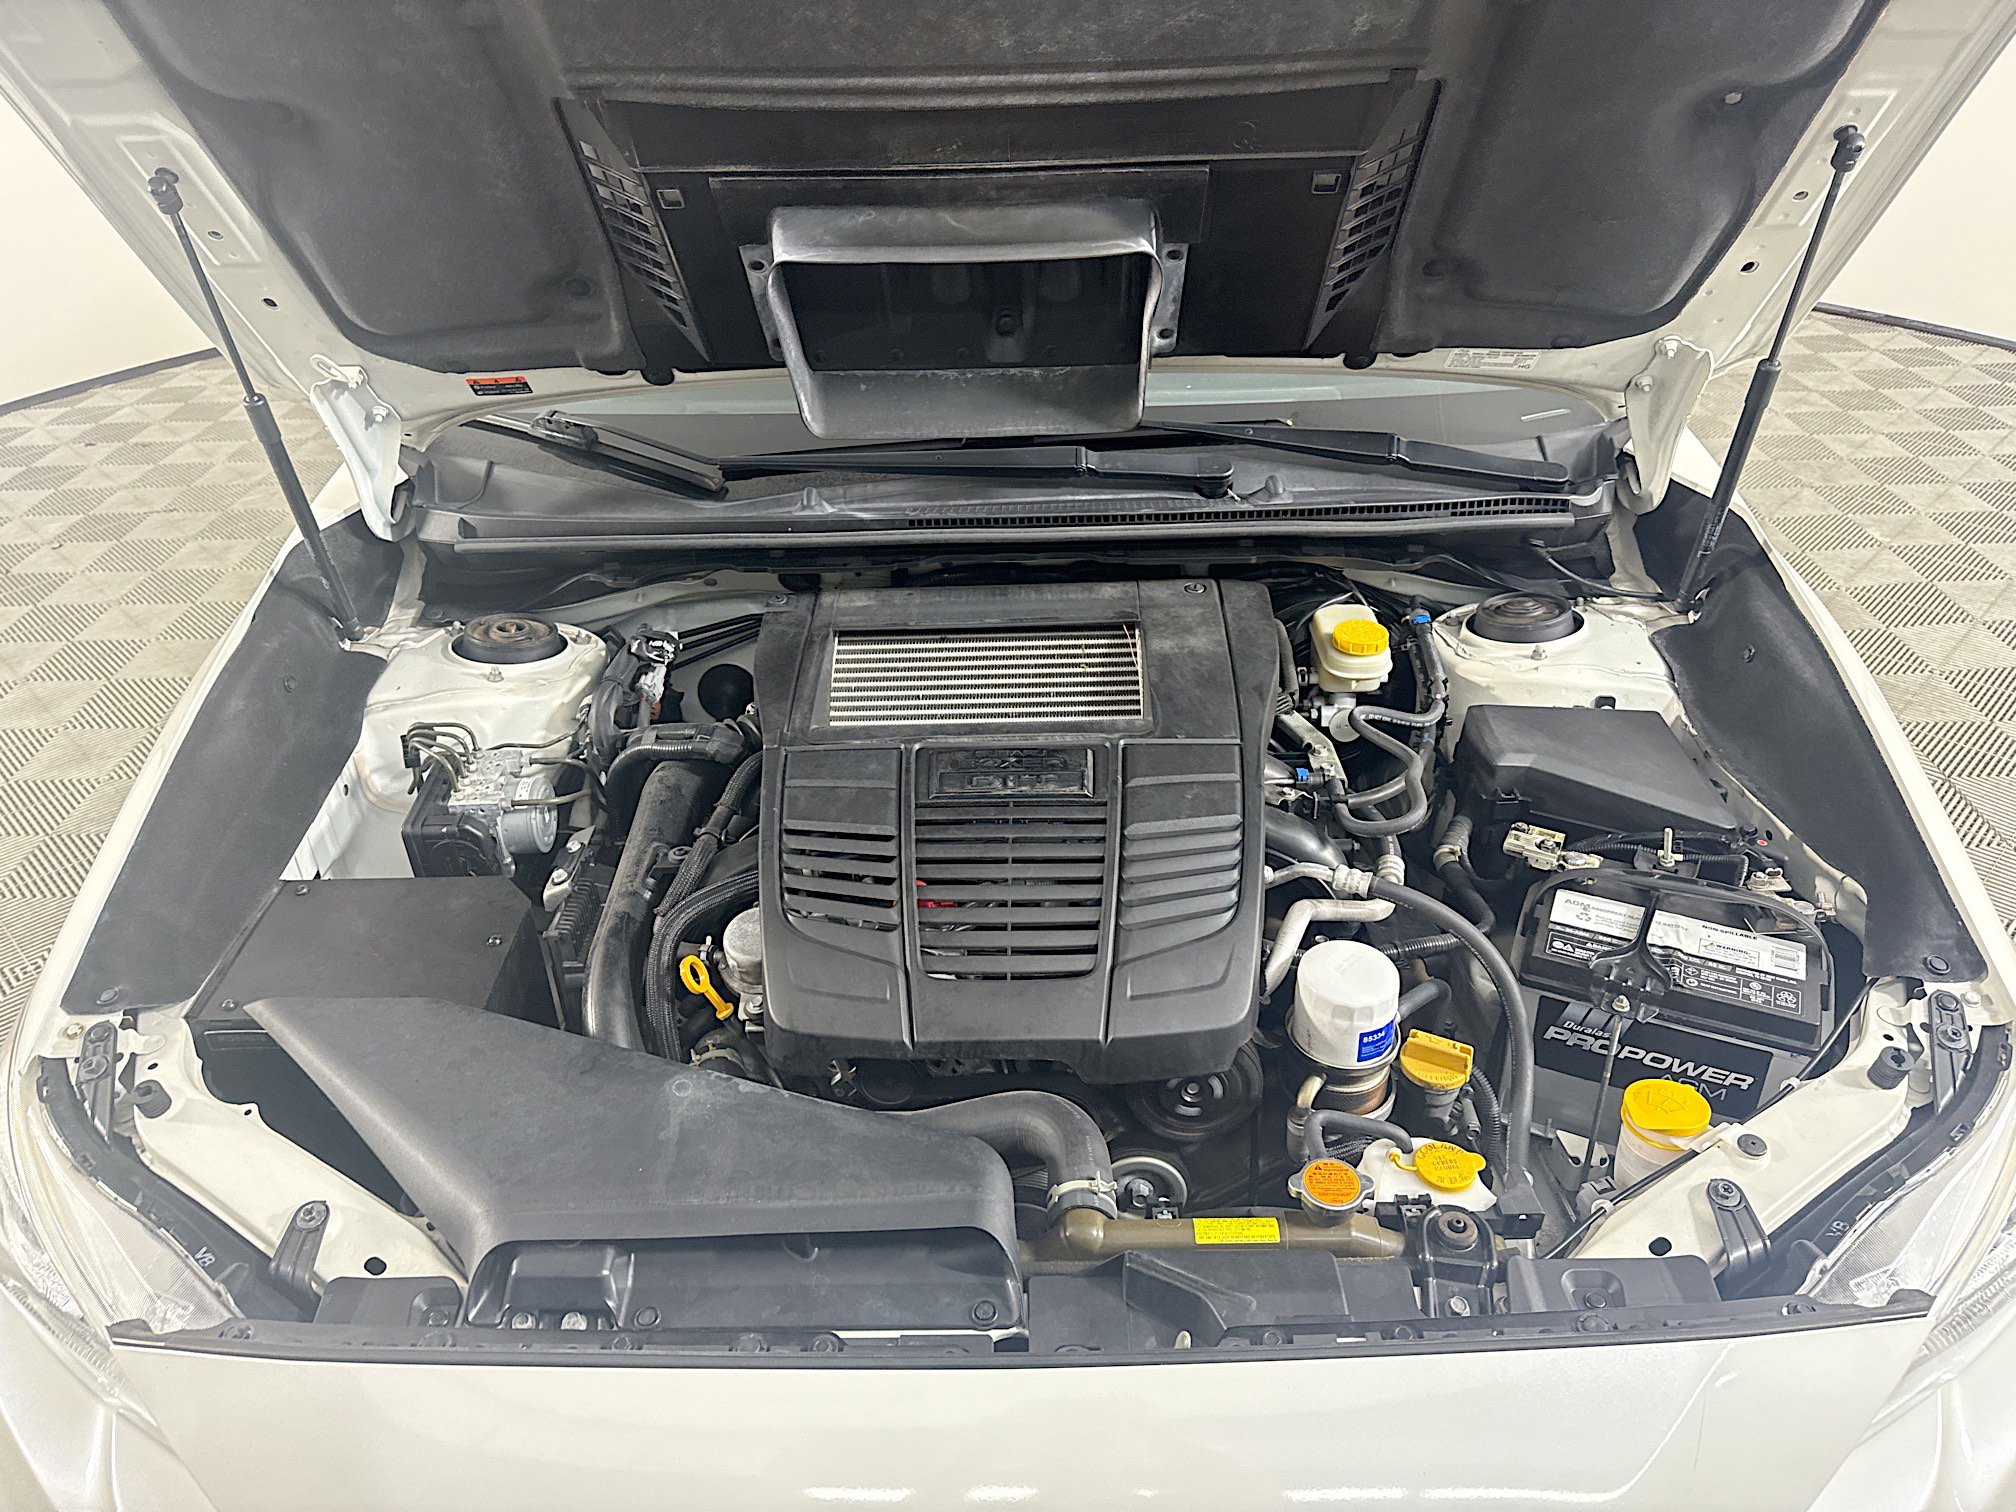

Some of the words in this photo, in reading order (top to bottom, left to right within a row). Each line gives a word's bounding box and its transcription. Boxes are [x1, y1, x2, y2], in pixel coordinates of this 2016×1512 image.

[1565, 899, 1591, 908] AGM
[1563, 1020, 1612, 1038] Duralas
[1363, 1031, 1385, 1043] 85334
